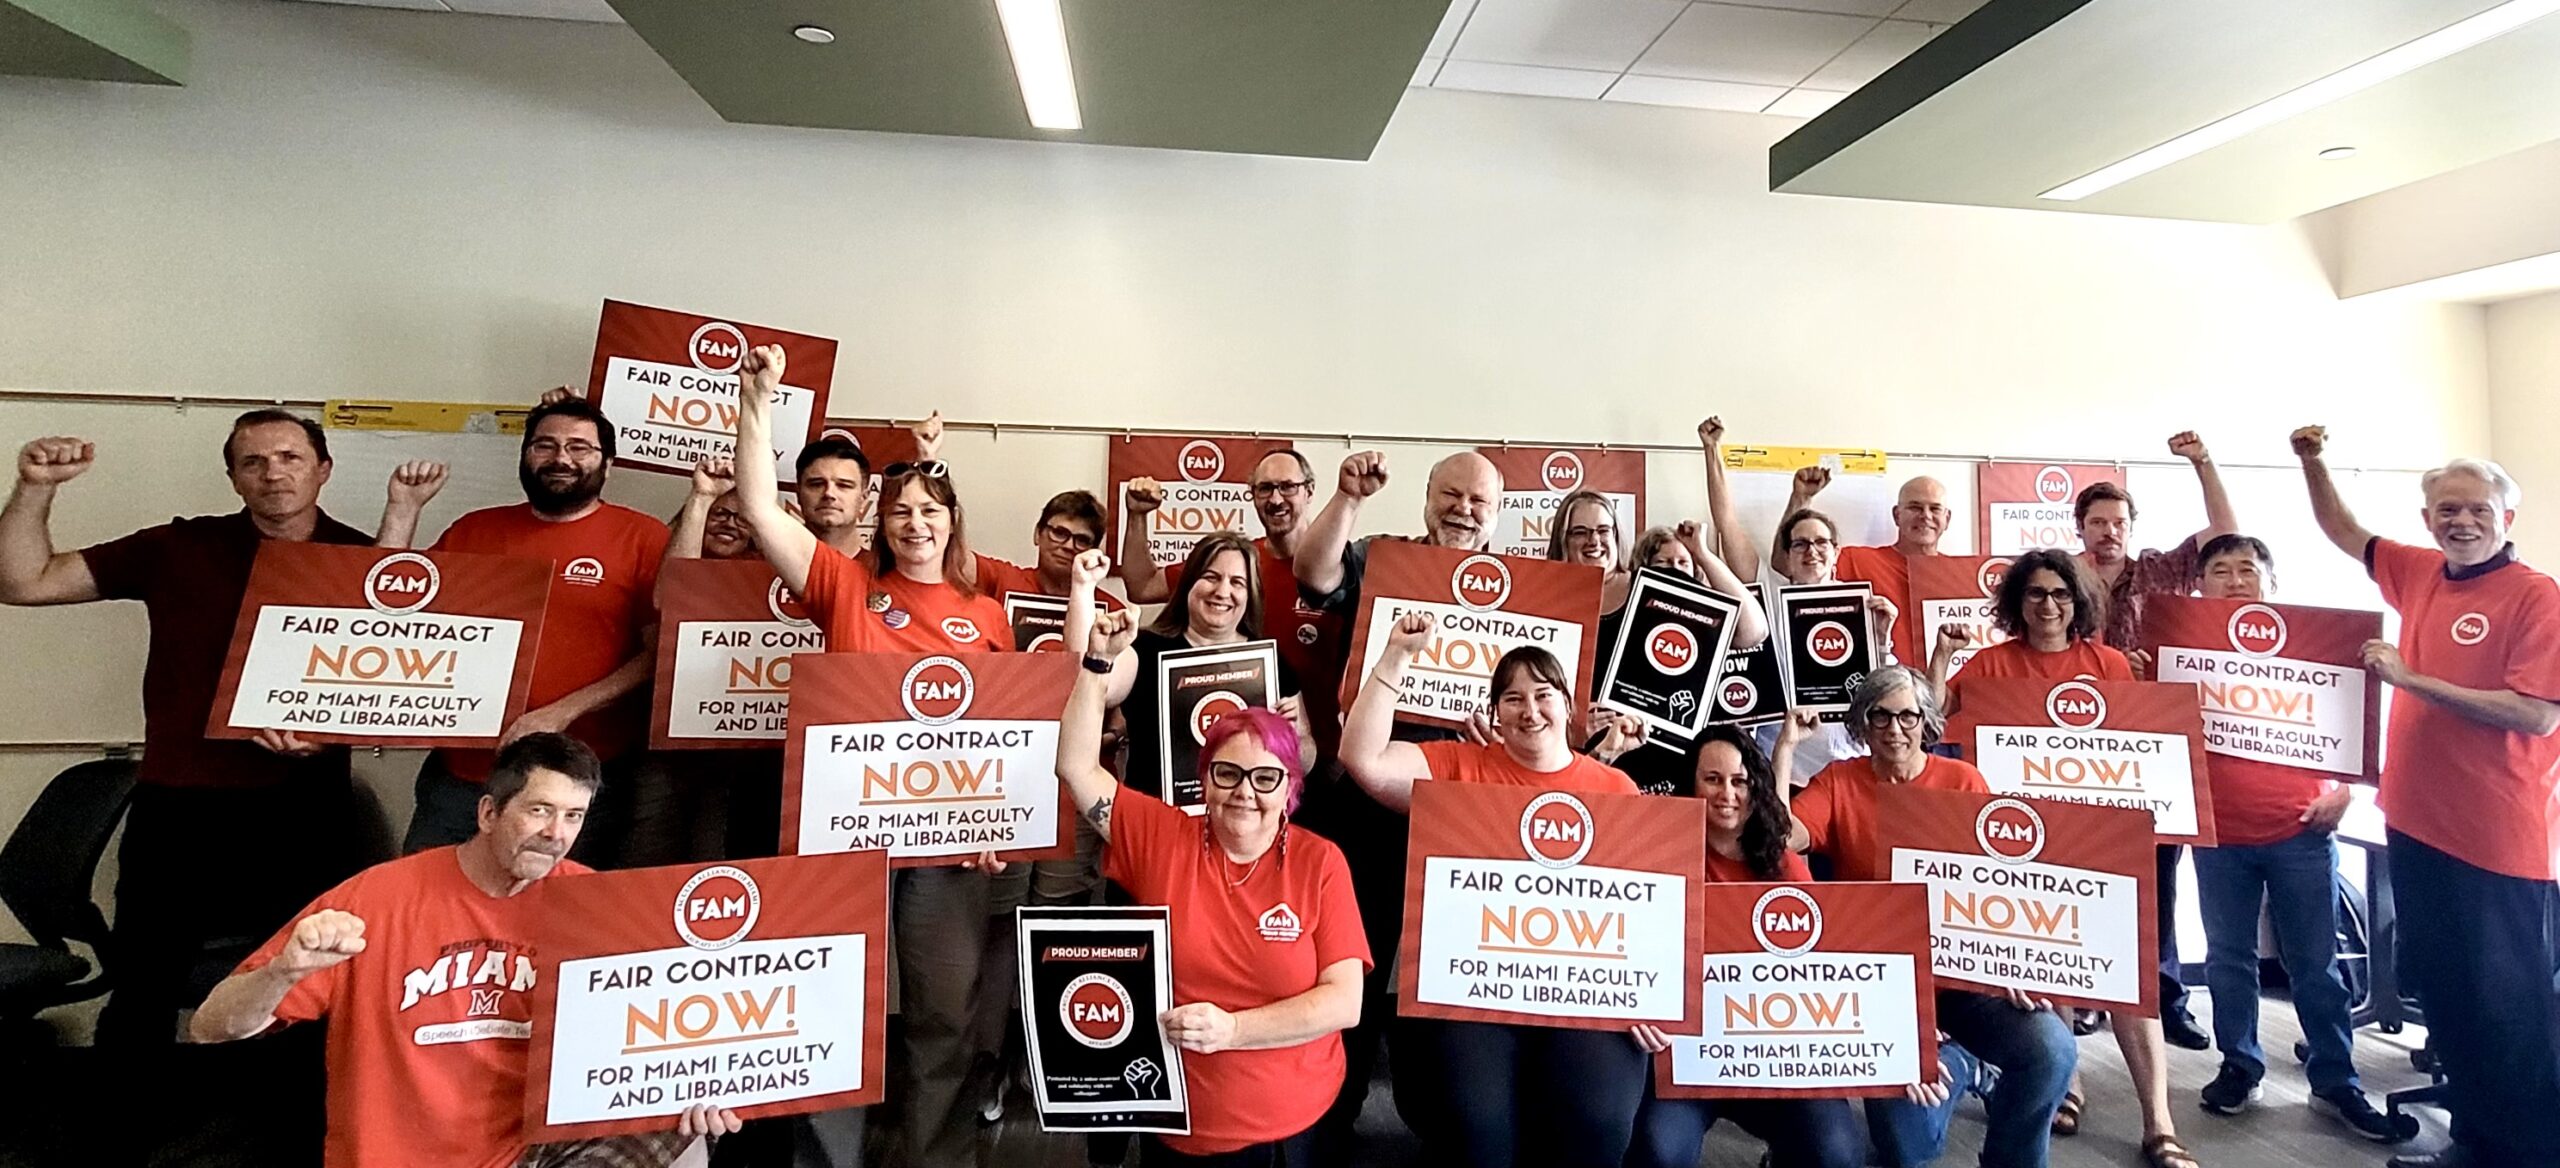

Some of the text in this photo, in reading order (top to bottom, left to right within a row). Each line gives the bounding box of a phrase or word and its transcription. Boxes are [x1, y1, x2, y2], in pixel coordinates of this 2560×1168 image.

[699, 339, 738, 359] FAM
[627, 366, 671, 387] FAIR
[620, 427, 651, 442] FOR
[658, 434, 707, 452] MIAMI
[633, 444, 670, 459] AND
[1187, 456, 1217, 469] FAM
[1549, 466, 1577, 479] FAM
[1175, 489, 1254, 502] CONTRAC
[2042, 480, 2067, 493] FAM
[1503, 498, 1533, 510] FAIR
[2003, 509, 2030, 520] FAIR
[1156, 507, 1244, 531] NOW!
[1506, 547, 1527, 556] FOR
[377, 574, 427, 593] FAM
[1463, 573, 1501, 593] FAM
[1653, 599, 1714, 625] PROUD MEMBER
[1825, 606, 1854, 614] MEMBER
[1939, 606, 1971, 618] FAIR
[282, 616, 493, 643] FAIR CONTRACT
[702, 631, 825, 648] FAIR CONT
[1443, 615, 1559, 643] CONTRACT
[2238, 622, 2276, 641] FAM
[1654, 639, 1689, 661] FAM
[1815, 638, 1845, 651] FAM
[305, 645, 457, 683] NOW!
[1724, 657, 1749, 673] OW
[2175, 655, 2341, 688] FAIR CONTRACT
[1185, 671, 1253, 685] PROUD MEMBER
[1422, 677, 1471, 697] MIAMI
[267, 690, 481, 712] FOR MIAMI FACULTY
[915, 681, 961, 700] FAM
[1397, 693, 1433, 708] AND
[1725, 689, 1749, 702] FAM
[2201, 680, 2313, 721] NOW!
[700, 701, 734, 714] FOR
[2057, 699, 2095, 715] FAM
[282, 710, 456, 728] AND LIBRARIANS
[715, 718, 757, 731] AND
[831, 730, 1033, 753] FAIR CONTRACT
[1995, 733, 2163, 754] FAIR CONTRACT
[2212, 720, 2341, 750] MIAMI FACULTY
[2203, 733, 2324, 762] ND LIBRARIANS
[863, 759, 1003, 798] NOW!
[2023, 755, 2141, 787] NOW!
[831, 807, 1034, 830] FOR MIAMI FACULTY
[849, 827, 1015, 849] AND LIBRARIANS
[1534, 818, 1581, 842] FAM
[1988, 820, 2033, 842] FAM
[1450, 870, 1656, 902] FAIR CONTRACT
[1914, 859, 2108, 898] FAIR CONTRACT
[688, 894, 745, 922] FAM
[1944, 889, 2078, 939] NOW!
[1481, 904, 1625, 952] NOW!
[1765, 912, 1811, 932] FAM
[1051, 947, 1138, 958] PROUD MEMBER
[1930, 935, 2113, 973] OR MIAMI FACULTY
[400, 949, 538, 1012] MIAM
[589, 947, 832, 993] FAIR CONTRACT
[1450, 959, 1658, 988] FOR MIAMI FACULTY
[1703, 963, 1886, 983] AIR CONTRACT
[1934, 956, 2094, 989] AND LIBRARIANS
[467, 989, 504, 1016] M
[1468, 983, 1638, 1008] AND LIBRARIANS
[626, 985, 796, 1046] NOW!
[1074, 1003, 1119, 1022] FAM
[1724, 992, 1860, 1029] NOW!
[1699, 1043, 1894, 1059] FOR MIAMI FACULTY
[587, 1042, 834, 1088] FOR MIAMI FACULTY
[1719, 1062, 1877, 1078] AND LIBRARIANS
[609, 1069, 810, 1110] AND LIBRARIANS
